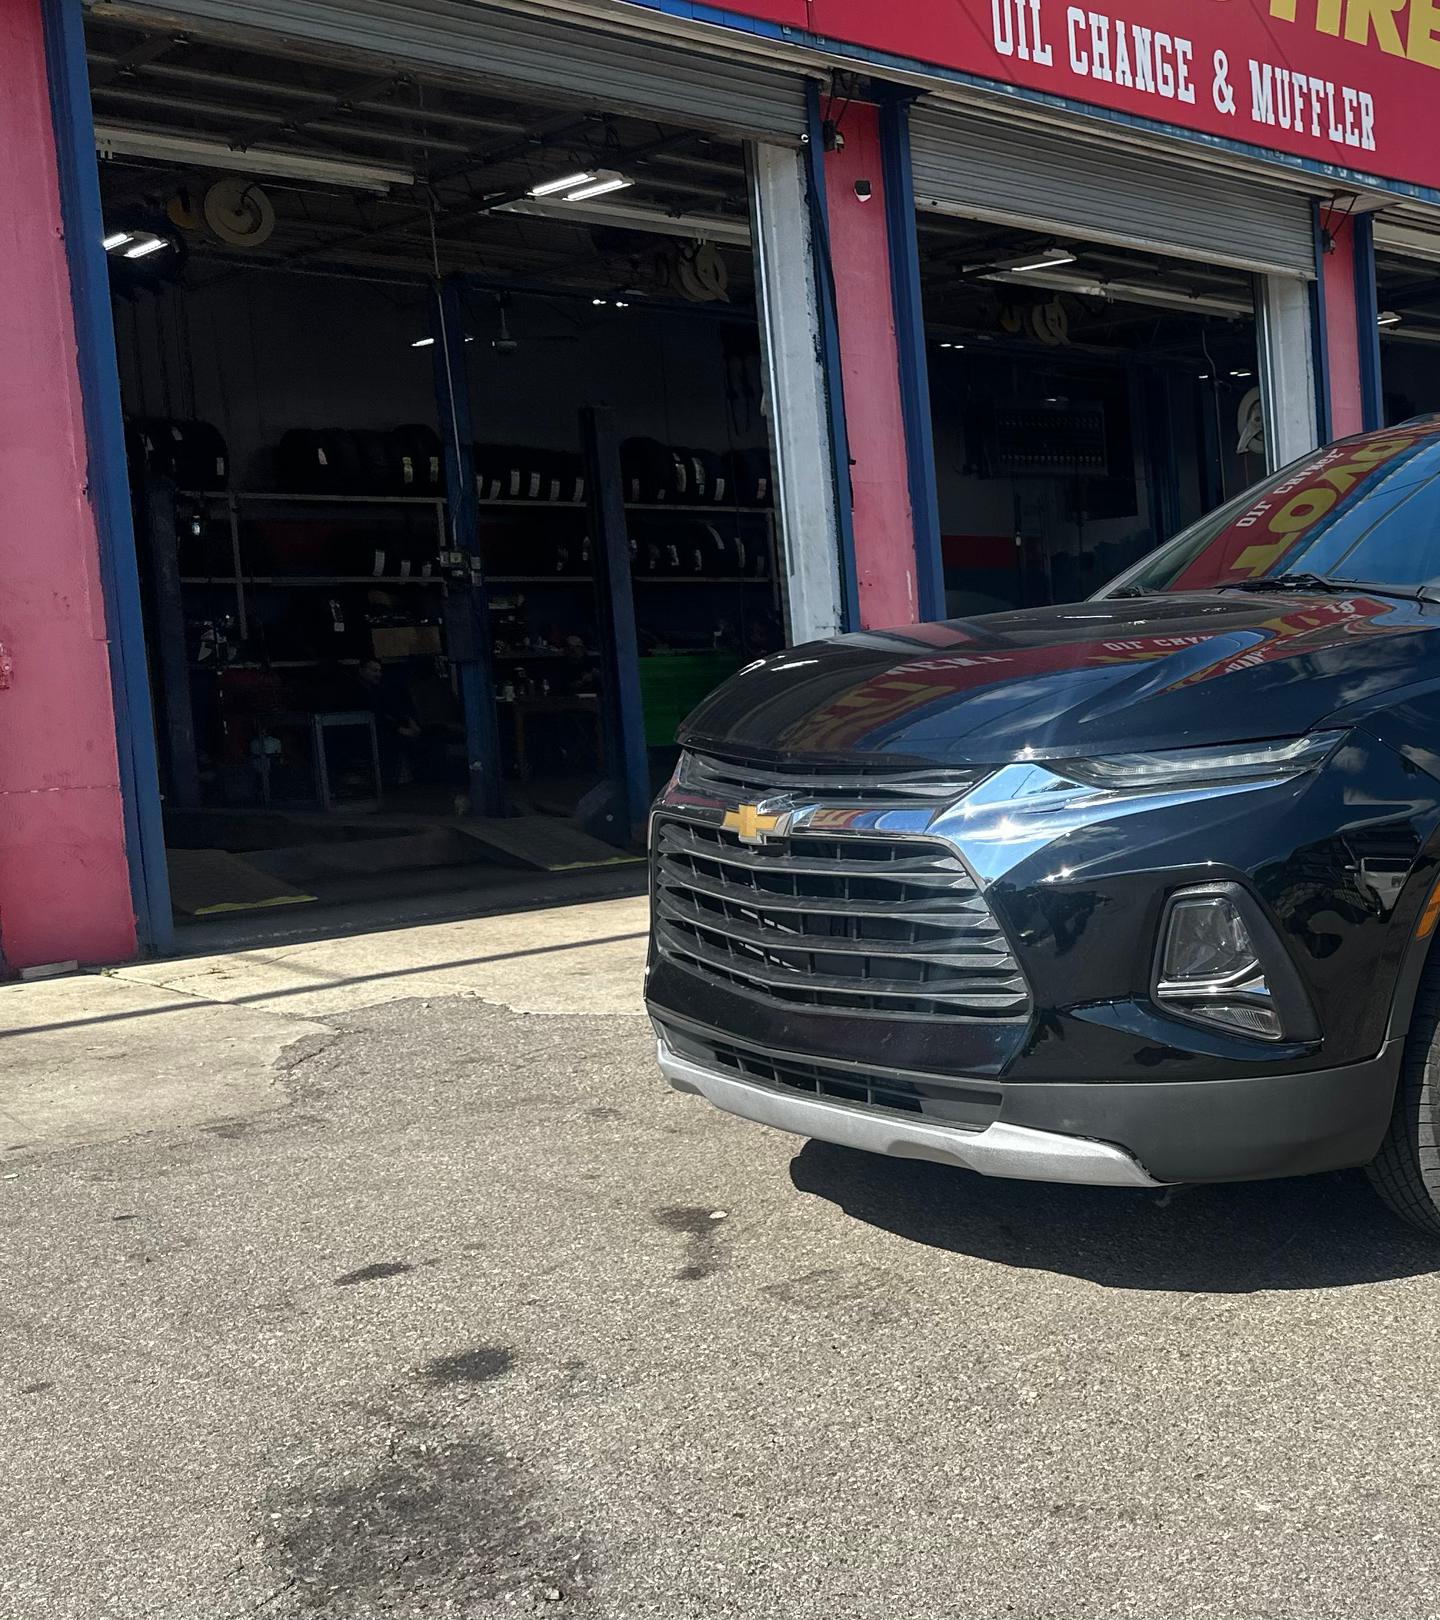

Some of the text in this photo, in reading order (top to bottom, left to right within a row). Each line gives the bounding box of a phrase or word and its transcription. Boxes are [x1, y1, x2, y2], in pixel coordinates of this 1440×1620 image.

[991, 0, 1377, 152] OIL CHANGE & MUFFLER
